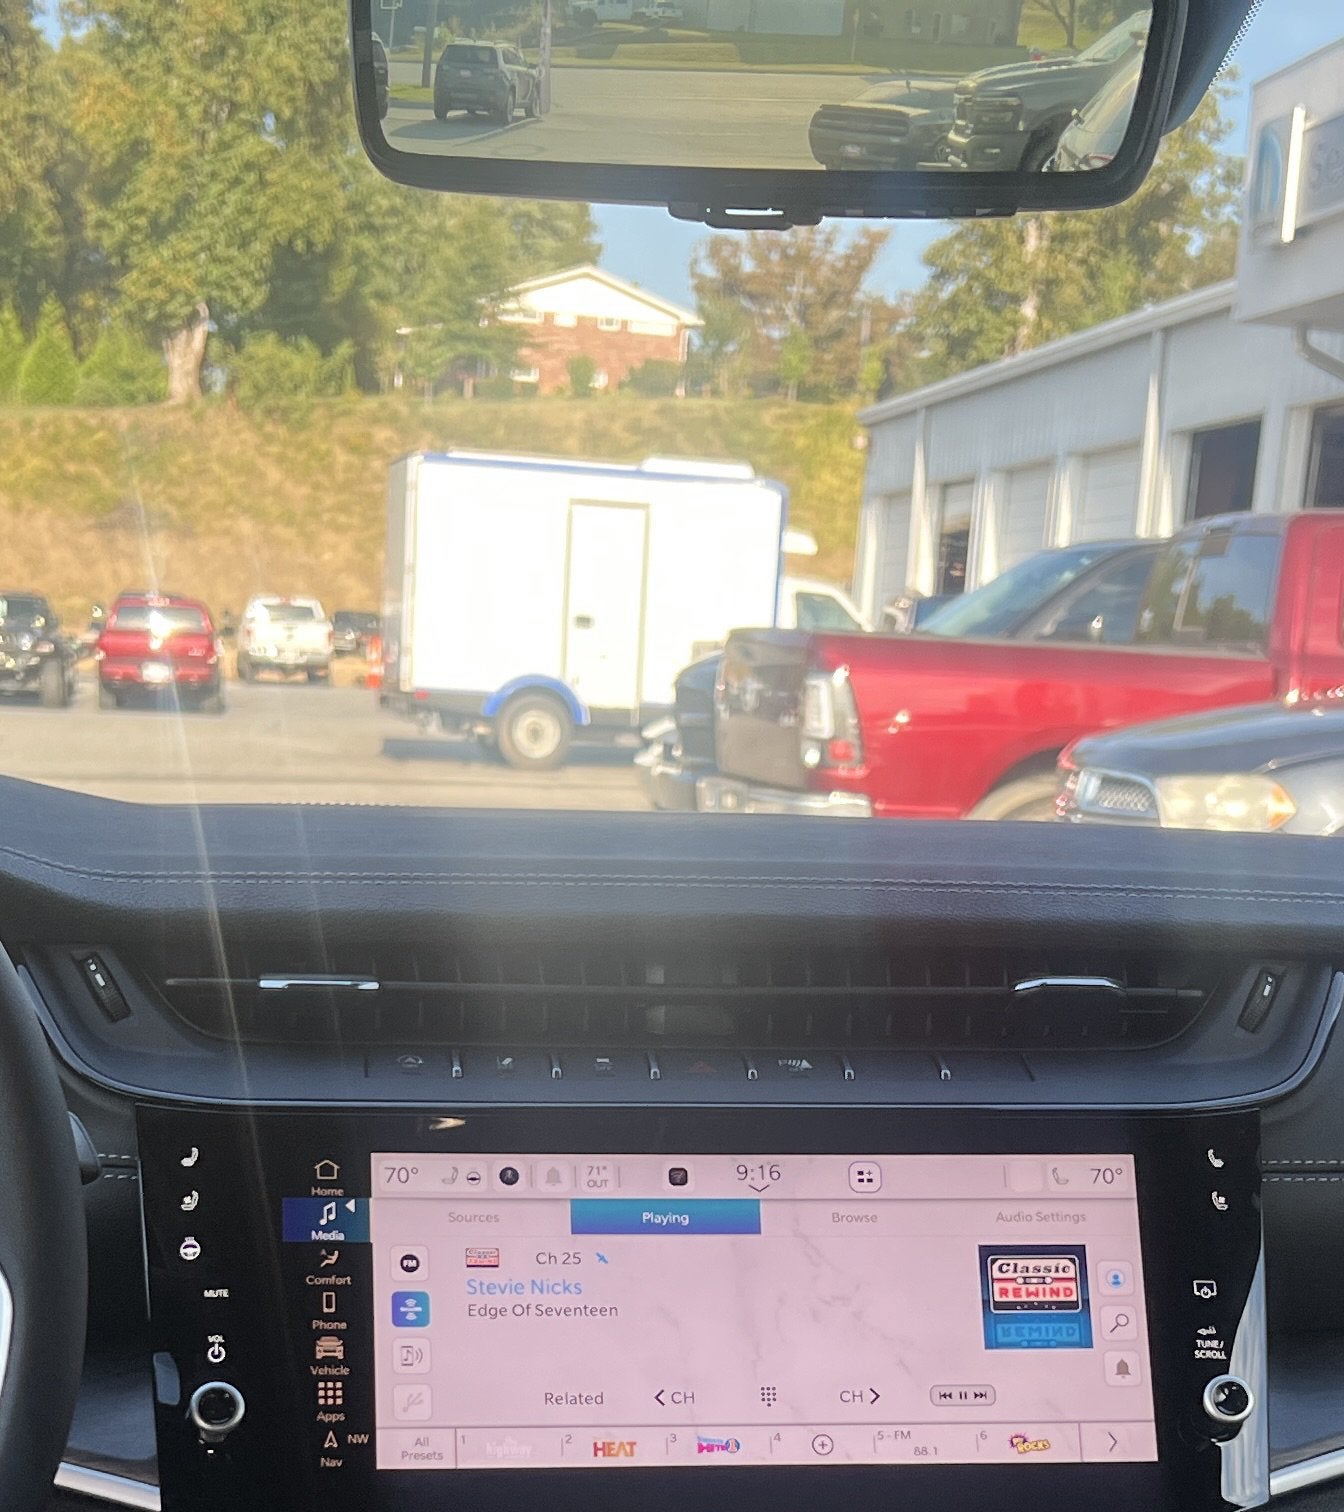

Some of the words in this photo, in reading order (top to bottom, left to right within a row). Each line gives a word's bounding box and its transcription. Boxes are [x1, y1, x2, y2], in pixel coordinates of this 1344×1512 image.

[736, 1164, 781, 1181] 9:16
[587, 1178, 608, 1188] OUT
[311, 1186, 344, 1197] Home
[448, 1212, 500, 1223] Sources
[642, 1212, 689, 1226] Playing
[832, 1212, 877, 1223] Browse
[996, 1212, 1033, 1223] Audio
[1036, 1212, 1086, 1225] Settings
[311, 1230, 345, 1241] Media
[536, 1252, 557, 1265] Ch
[561, 1252, 581, 1265] 25
[998, 1262, 1071, 1275] Classic
[306, 1275, 352, 1286] Comfort
[467, 1279, 524, 1295] Stevie
[531, 1278, 582, 1295] Nicks
[999, 1287, 1073, 1298] REWIND
[468, 1304, 508, 1320] Edge
[512, 1304, 532, 1317] Of
[535, 1304, 618, 1317] Seventeen
[312, 1320, 347, 1330] Phone
[1194, 1350, 1227, 1360] SCROLL
[310, 1365, 350, 1376] Vehicle
[544, 1391, 604, 1405] Related
[671, 1391, 695, 1404] CH
[840, 1390, 864, 1403] CH
[316, 1412, 345, 1423] Apps
[347, 1433, 370, 1444] NW
[565, 1435, 572, 1444] 2
[670, 1433, 677, 1443] 3
[773, 1432, 781, 1442] 4
[894, 1430, 912, 1440] FM
[980, 1431, 987, 1440] 6
[415, 1437, 429, 1447] All
[593, 1441, 637, 1458] HEAT
[913, 1447, 938, 1456] 88.1
[402, 1450, 443, 1461] Presets
[320, 1457, 343, 1467] Nav
